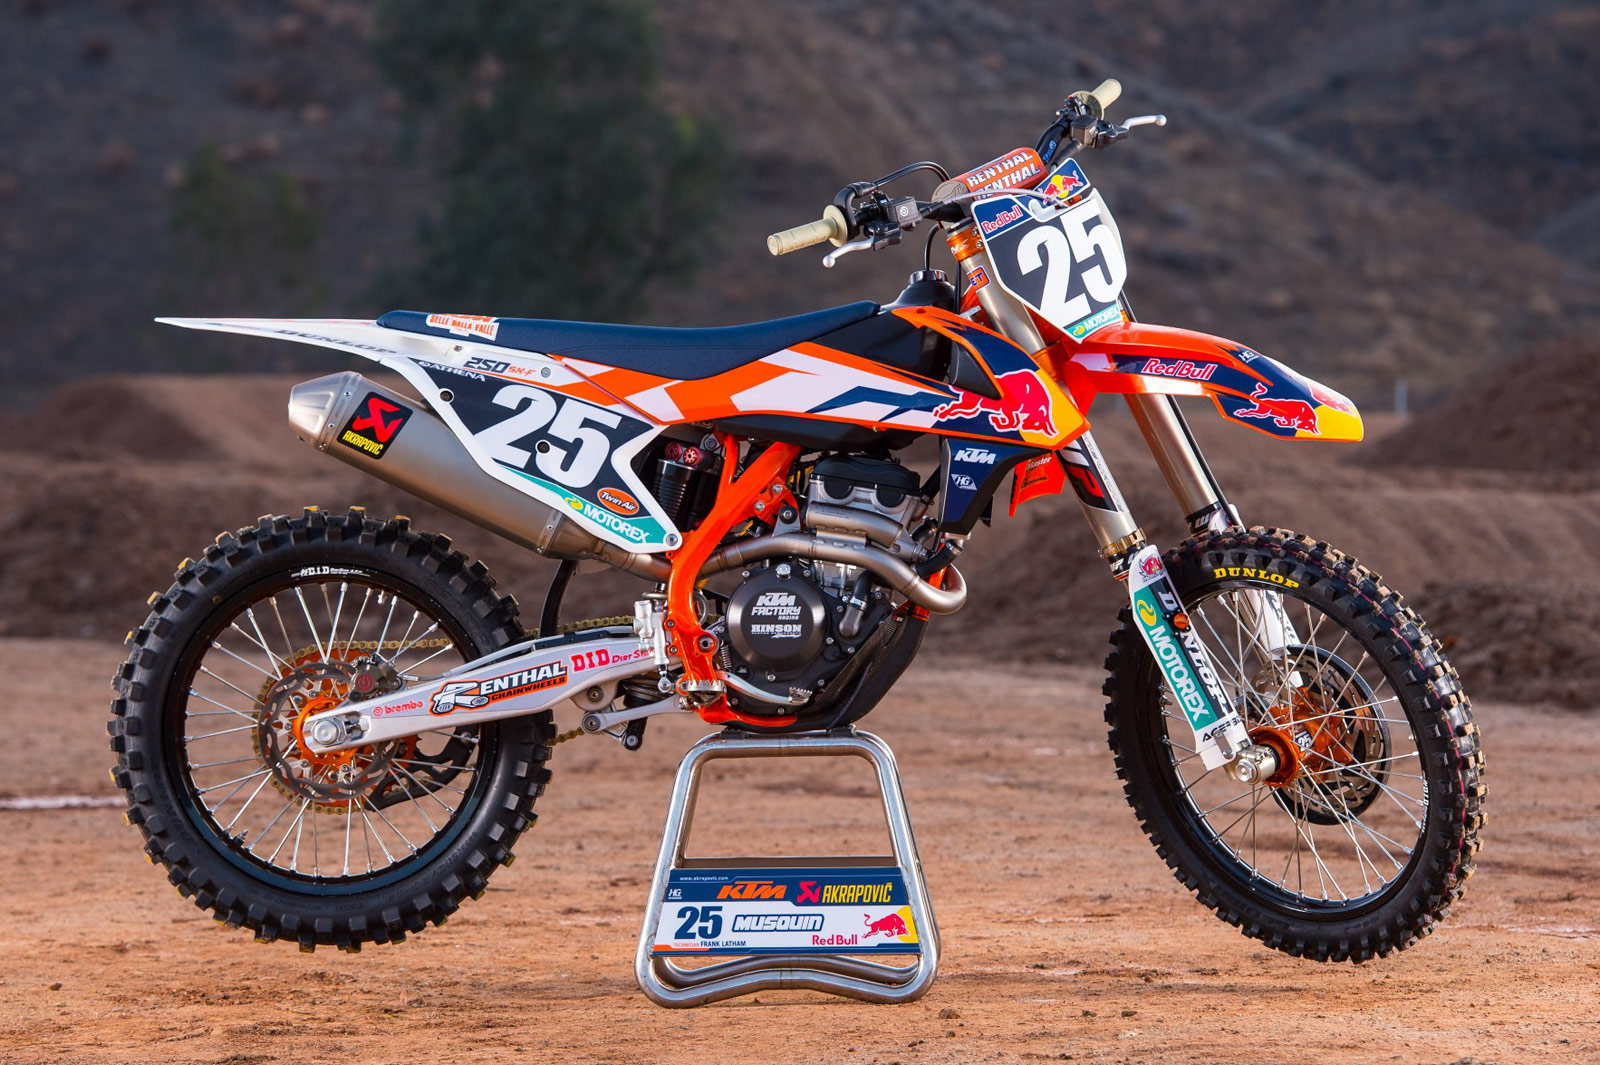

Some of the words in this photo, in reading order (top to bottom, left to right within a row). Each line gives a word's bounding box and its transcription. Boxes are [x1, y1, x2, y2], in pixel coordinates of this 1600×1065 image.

[966, 151, 1034, 188] RENTHAL
[981, 211, 1005, 234] Red
[1001, 205, 1024, 224] Bull
[1017, 199, 1124, 327] 25
[429, 314, 450, 326] SELLE
[451, 319, 473, 330] DALLA
[474, 323, 495, 336] VALLE
[1084, 306, 1121, 331] MOTOREX
[274, 329, 398, 354] DUNLOP
[427, 363, 486, 382] ATHENA
[463, 356, 511, 374] 250
[1141, 358, 1181, 376] Red
[1176, 361, 1218, 381] Bull
[473, 384, 623, 488] 25
[954, 447, 997, 465] KTM
[600, 490, 622, 506] Twin
[621, 500, 638, 512] Air
[583, 503, 650, 544] MOTOREX
[1213, 567, 1300, 589] DUNLOP
[756, 592, 796, 606] KTM
[751, 606, 802, 616] FACTORY
[751, 624, 802, 633] HINSON
[571, 649, 611, 672] D.I.D
[611, 654, 633, 664] DIRT
[1158, 591, 1229, 717] DNLOP
[1149, 625, 1210, 722] MOTOREX
[491, 677, 566, 701] CHAINWHEELS
[384, 700, 424, 714] brembo
[668, 888, 682, 897] HG
[716, 880, 788, 900] KTM
[822, 882, 893, 904] AKRAPOVIČ
[674, 906, 723, 939] 25
[812, 934, 834, 946] Red
[836, 934, 858, 946] Bull
